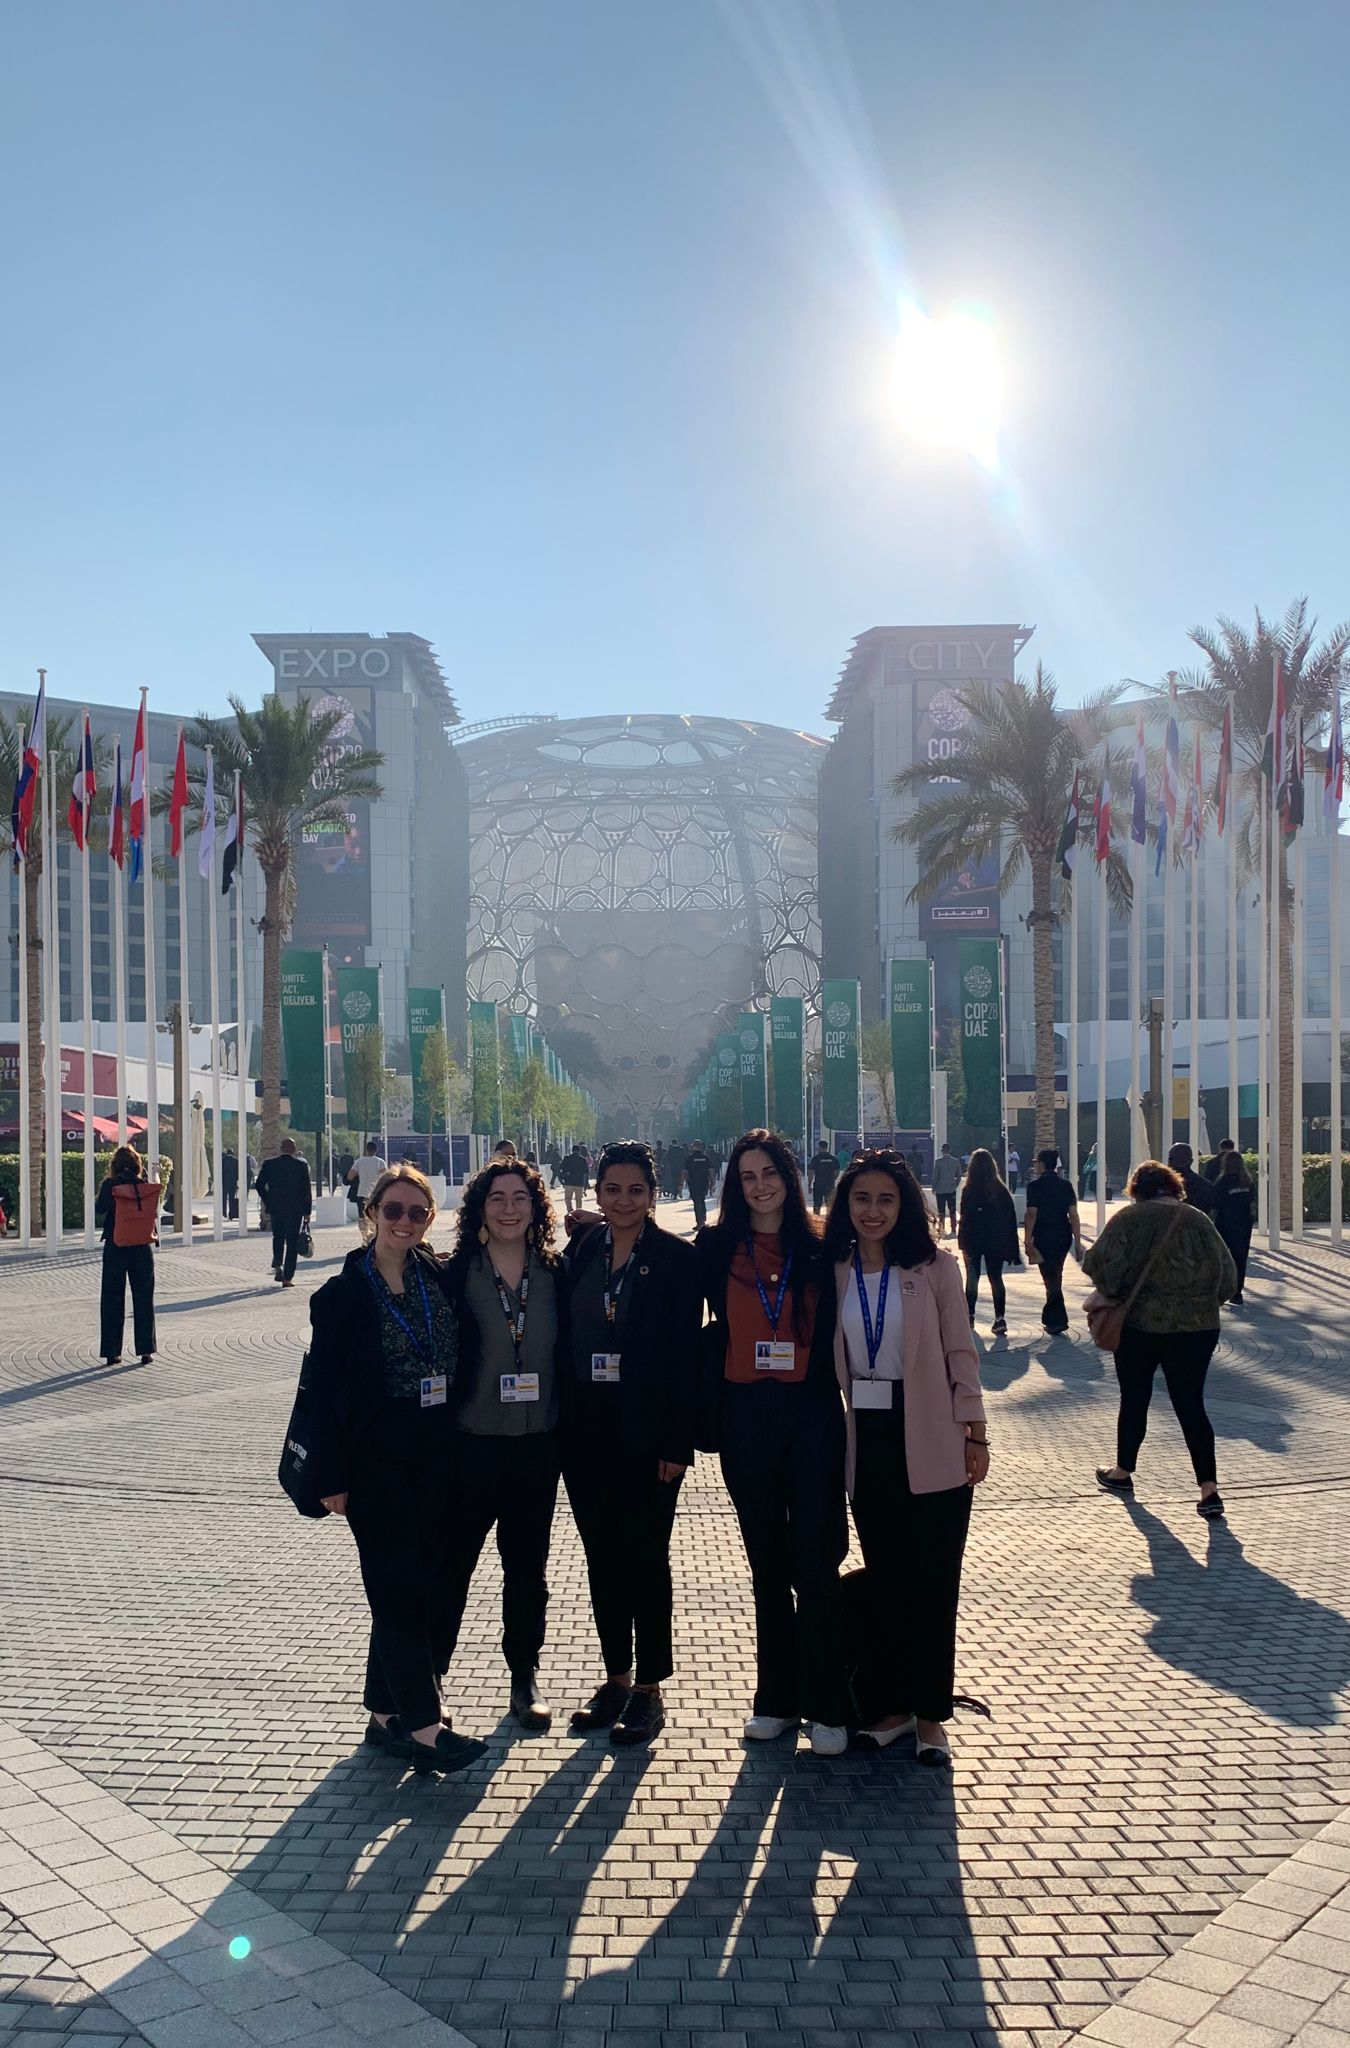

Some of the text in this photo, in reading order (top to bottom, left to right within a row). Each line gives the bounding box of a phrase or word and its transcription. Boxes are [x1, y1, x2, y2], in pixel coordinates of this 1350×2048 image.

[909, 640, 997, 671] CITY
[279, 648, 391, 678] EXPO
[302, 833, 319, 843] DAY
[282, 974, 307, 983] UNITE.
[282, 985, 299, 994] ACT.
[283, 995, 318, 1006] DELIVER.
[964, 1002, 998, 1020] COP28
[964, 1020, 988, 1037] UAE
[825, 1045, 846, 1058] UAE
[740, 1053, 763, 1065] COP28
[740, 1064, 756, 1076] UAE
